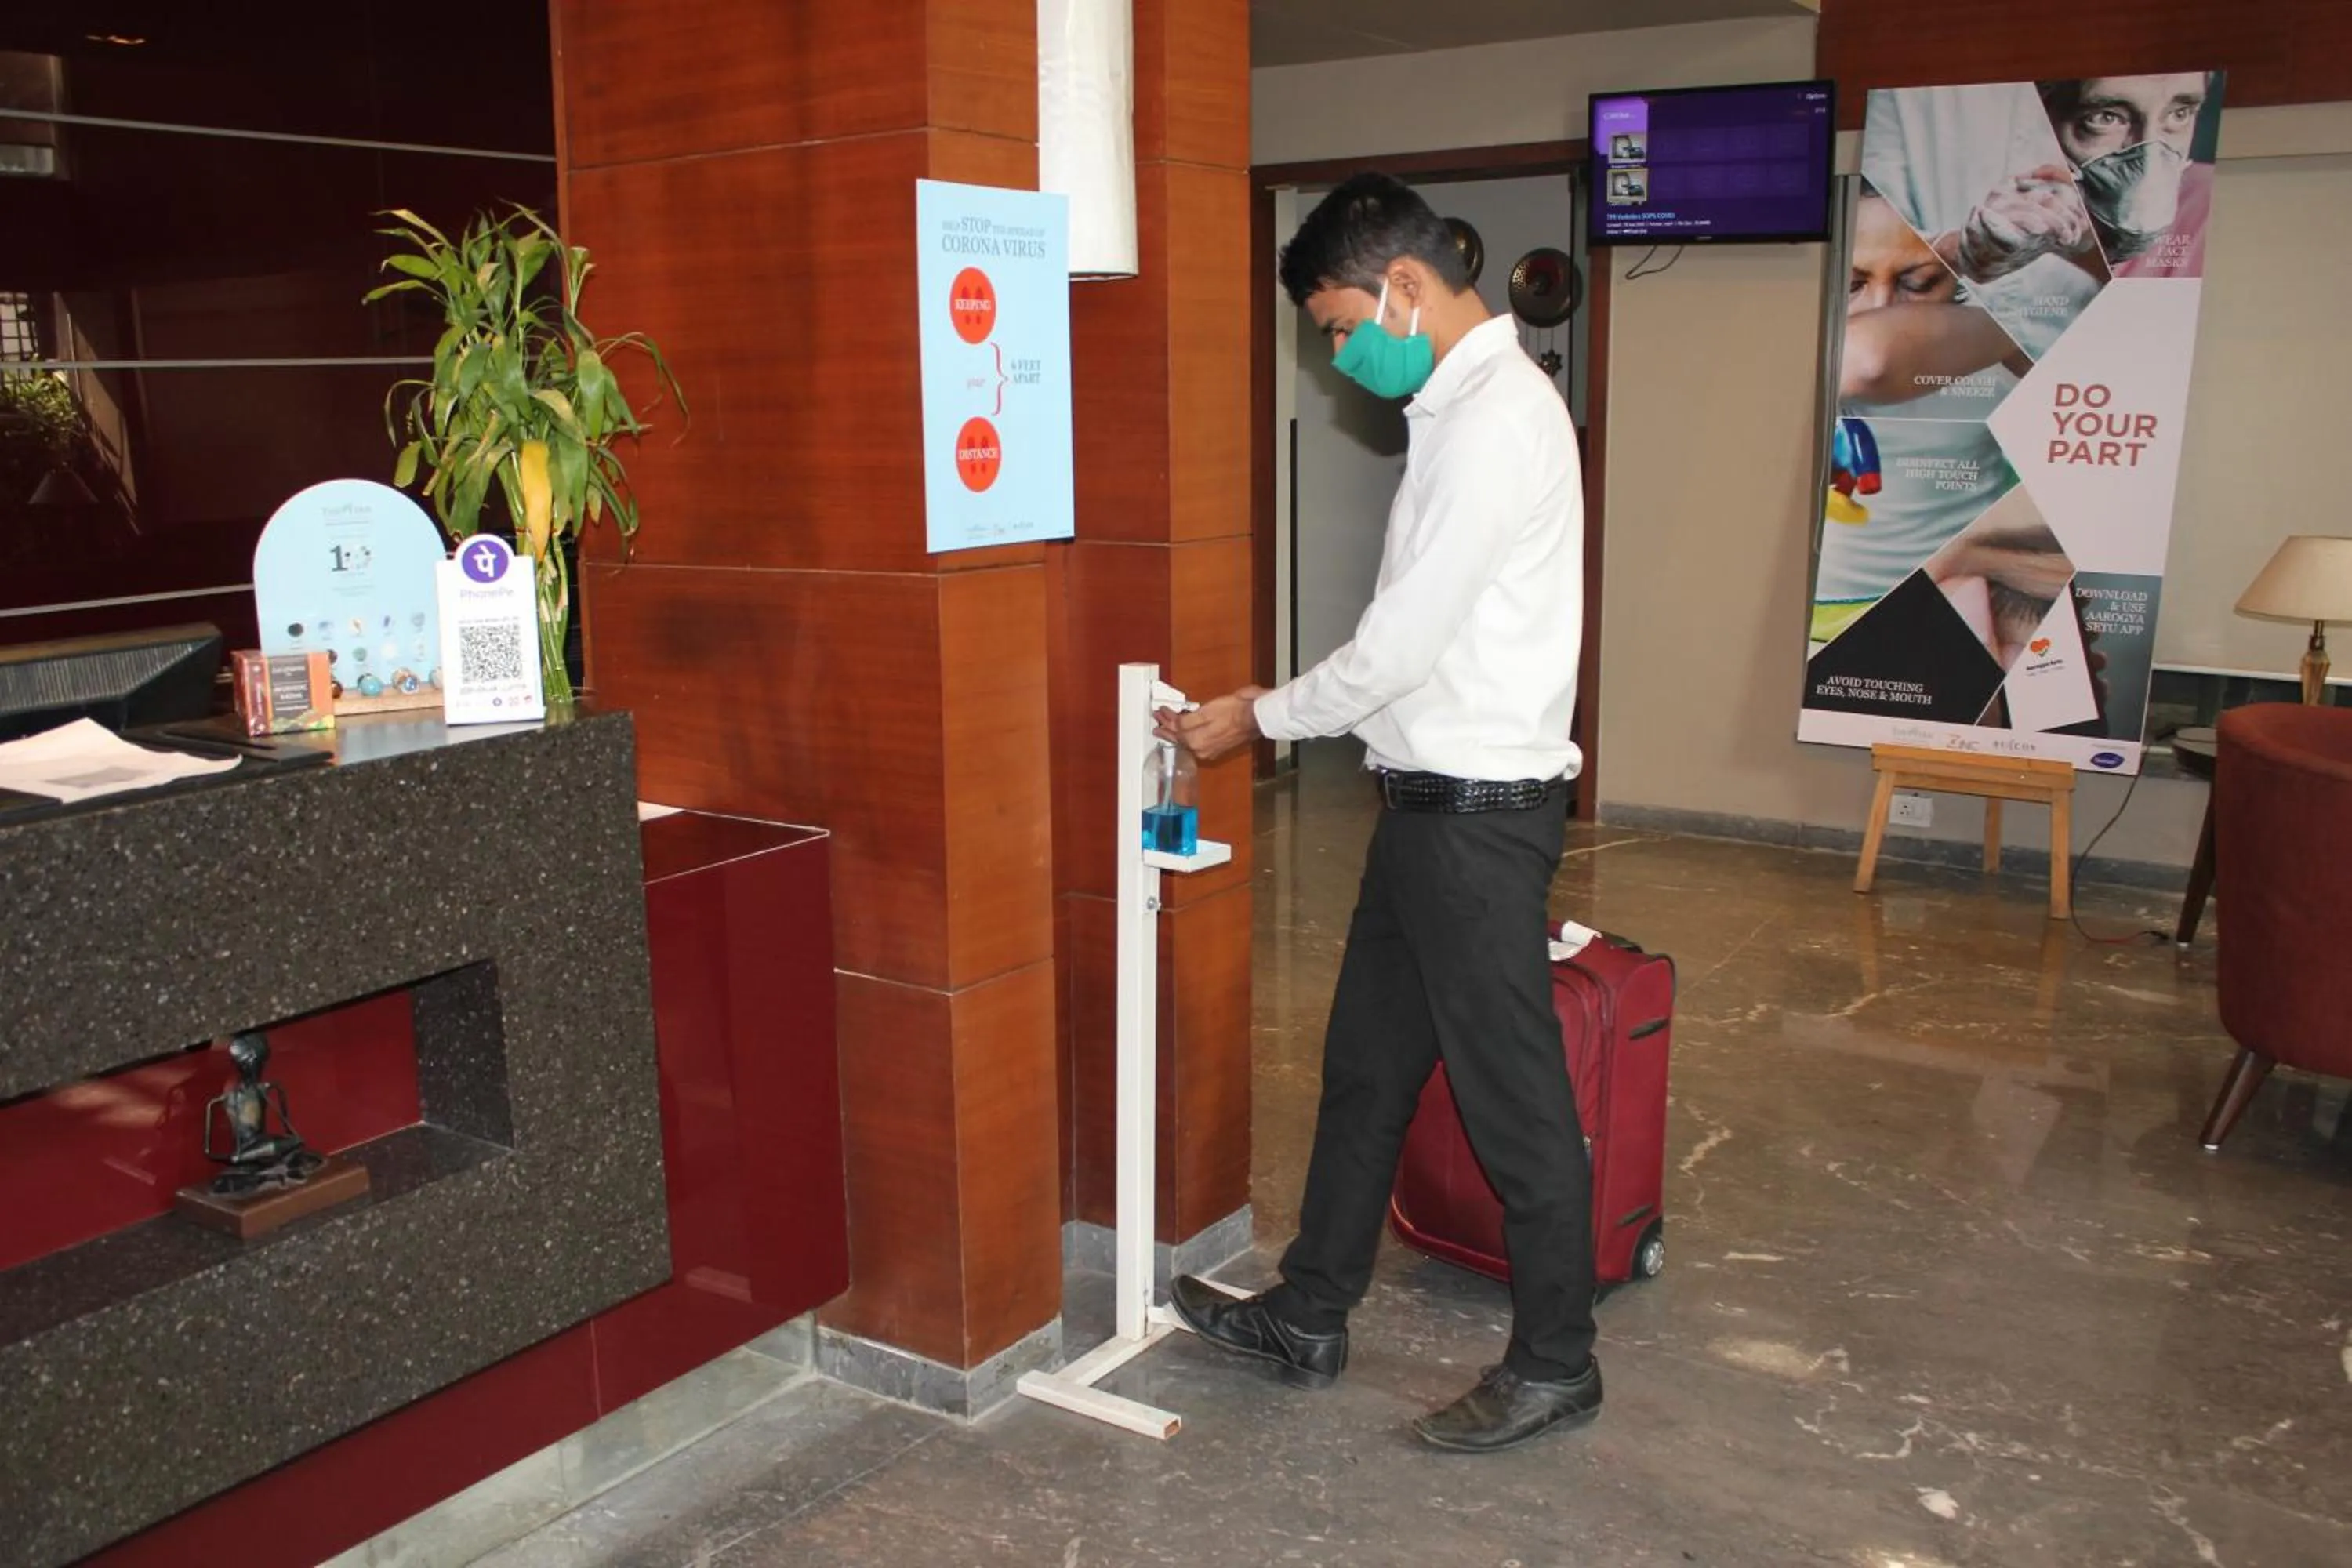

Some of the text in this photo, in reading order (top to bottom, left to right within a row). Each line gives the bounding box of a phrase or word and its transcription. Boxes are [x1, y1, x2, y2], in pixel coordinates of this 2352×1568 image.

[960, 216, 992, 235] STOP
[941, 234, 1047, 259] CORONA VIRUS
[955, 299, 992, 311] KEEPING
[1012, 372, 1042, 384] APART
[1914, 376, 1996, 387] COVER COUGH
[1940, 387, 1995, 397] & SNEEZE
[2054, 383, 2112, 409] DO
[2051, 412, 2158, 439] YOUR
[959, 448, 998, 461] DISTANCE
[2047, 439, 2147, 467] PART
[1896, 456, 1980, 470] DISINFECT ALL
[1905, 469, 1978, 481] HIGH TOUCH
[1935, 480, 1977, 491] POINTS
[473, 544, 497, 578] पे
[2075, 587, 2148, 601] DOWNLOAD
[2122, 601, 2147, 613] USE
[2085, 611, 2145, 624] AAROGYA
[2085, 622, 2144, 635] SETU APP
[1827, 675, 1923, 693] AVOID TOUCHING
[1816, 684, 1933, 705] EYES, NOSE & MOUTH
